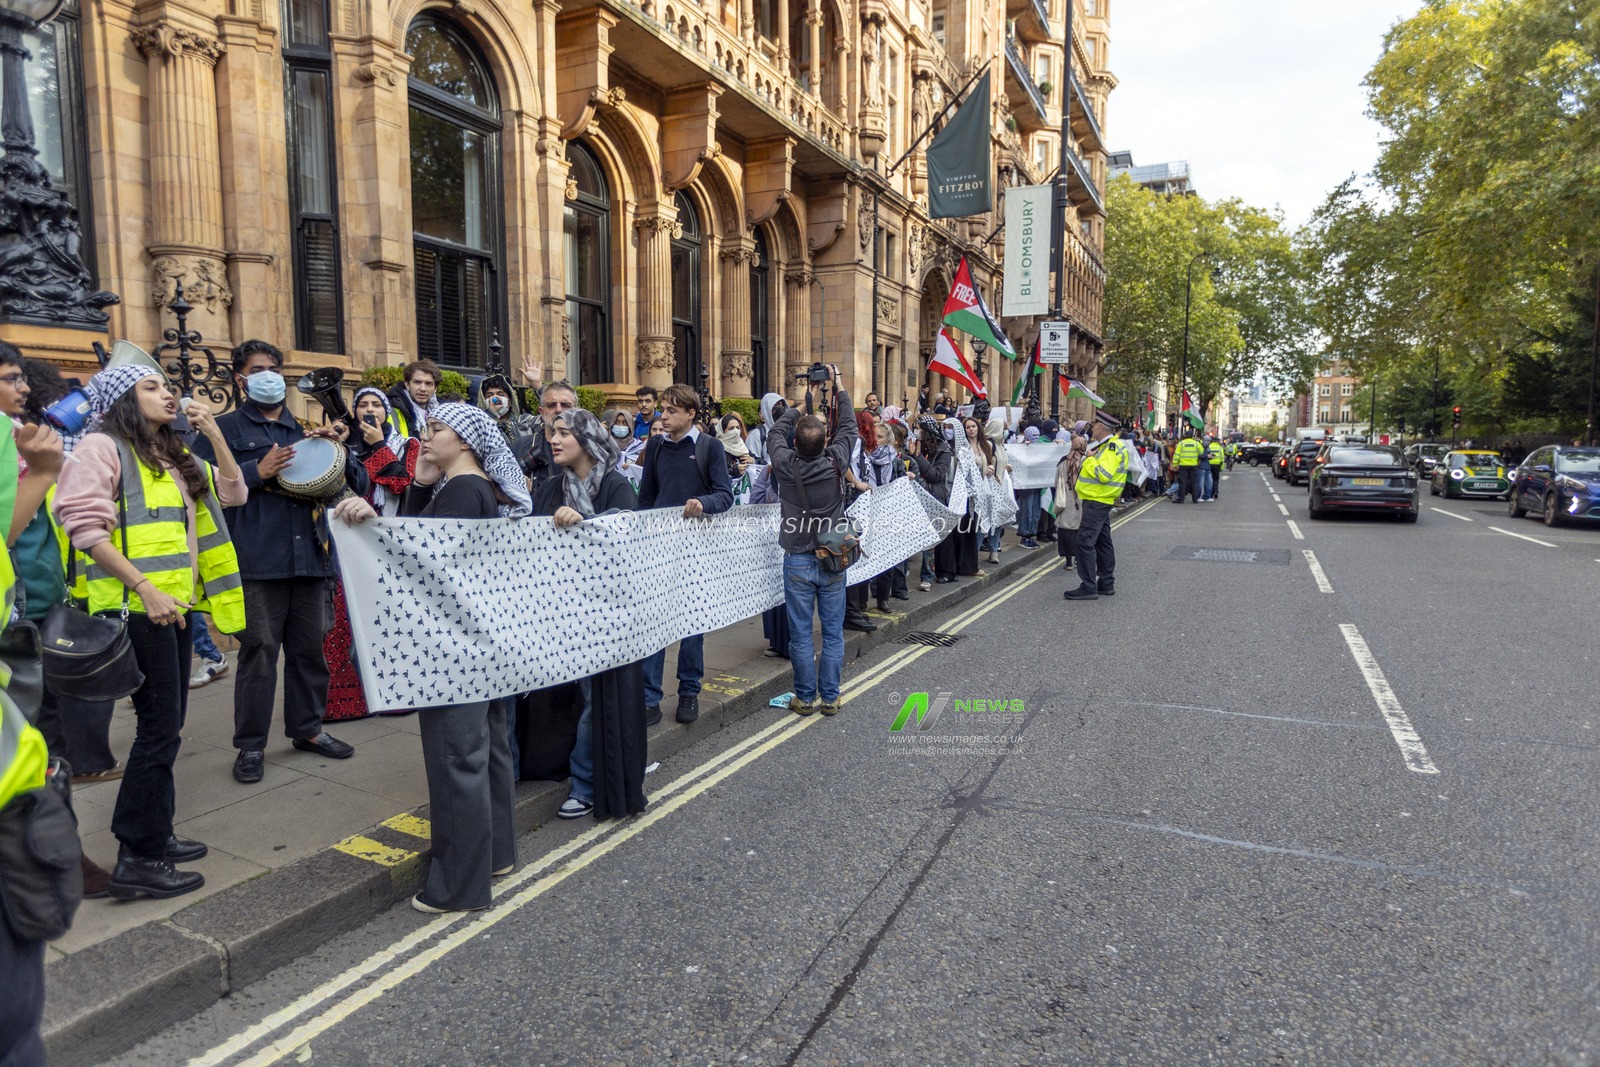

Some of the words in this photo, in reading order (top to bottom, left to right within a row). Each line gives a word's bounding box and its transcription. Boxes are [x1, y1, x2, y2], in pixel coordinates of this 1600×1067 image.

[946, 174, 977, 182] KIMPTON
[939, 180, 984, 194] FITZROY
[952, 282, 976, 306] FREE
